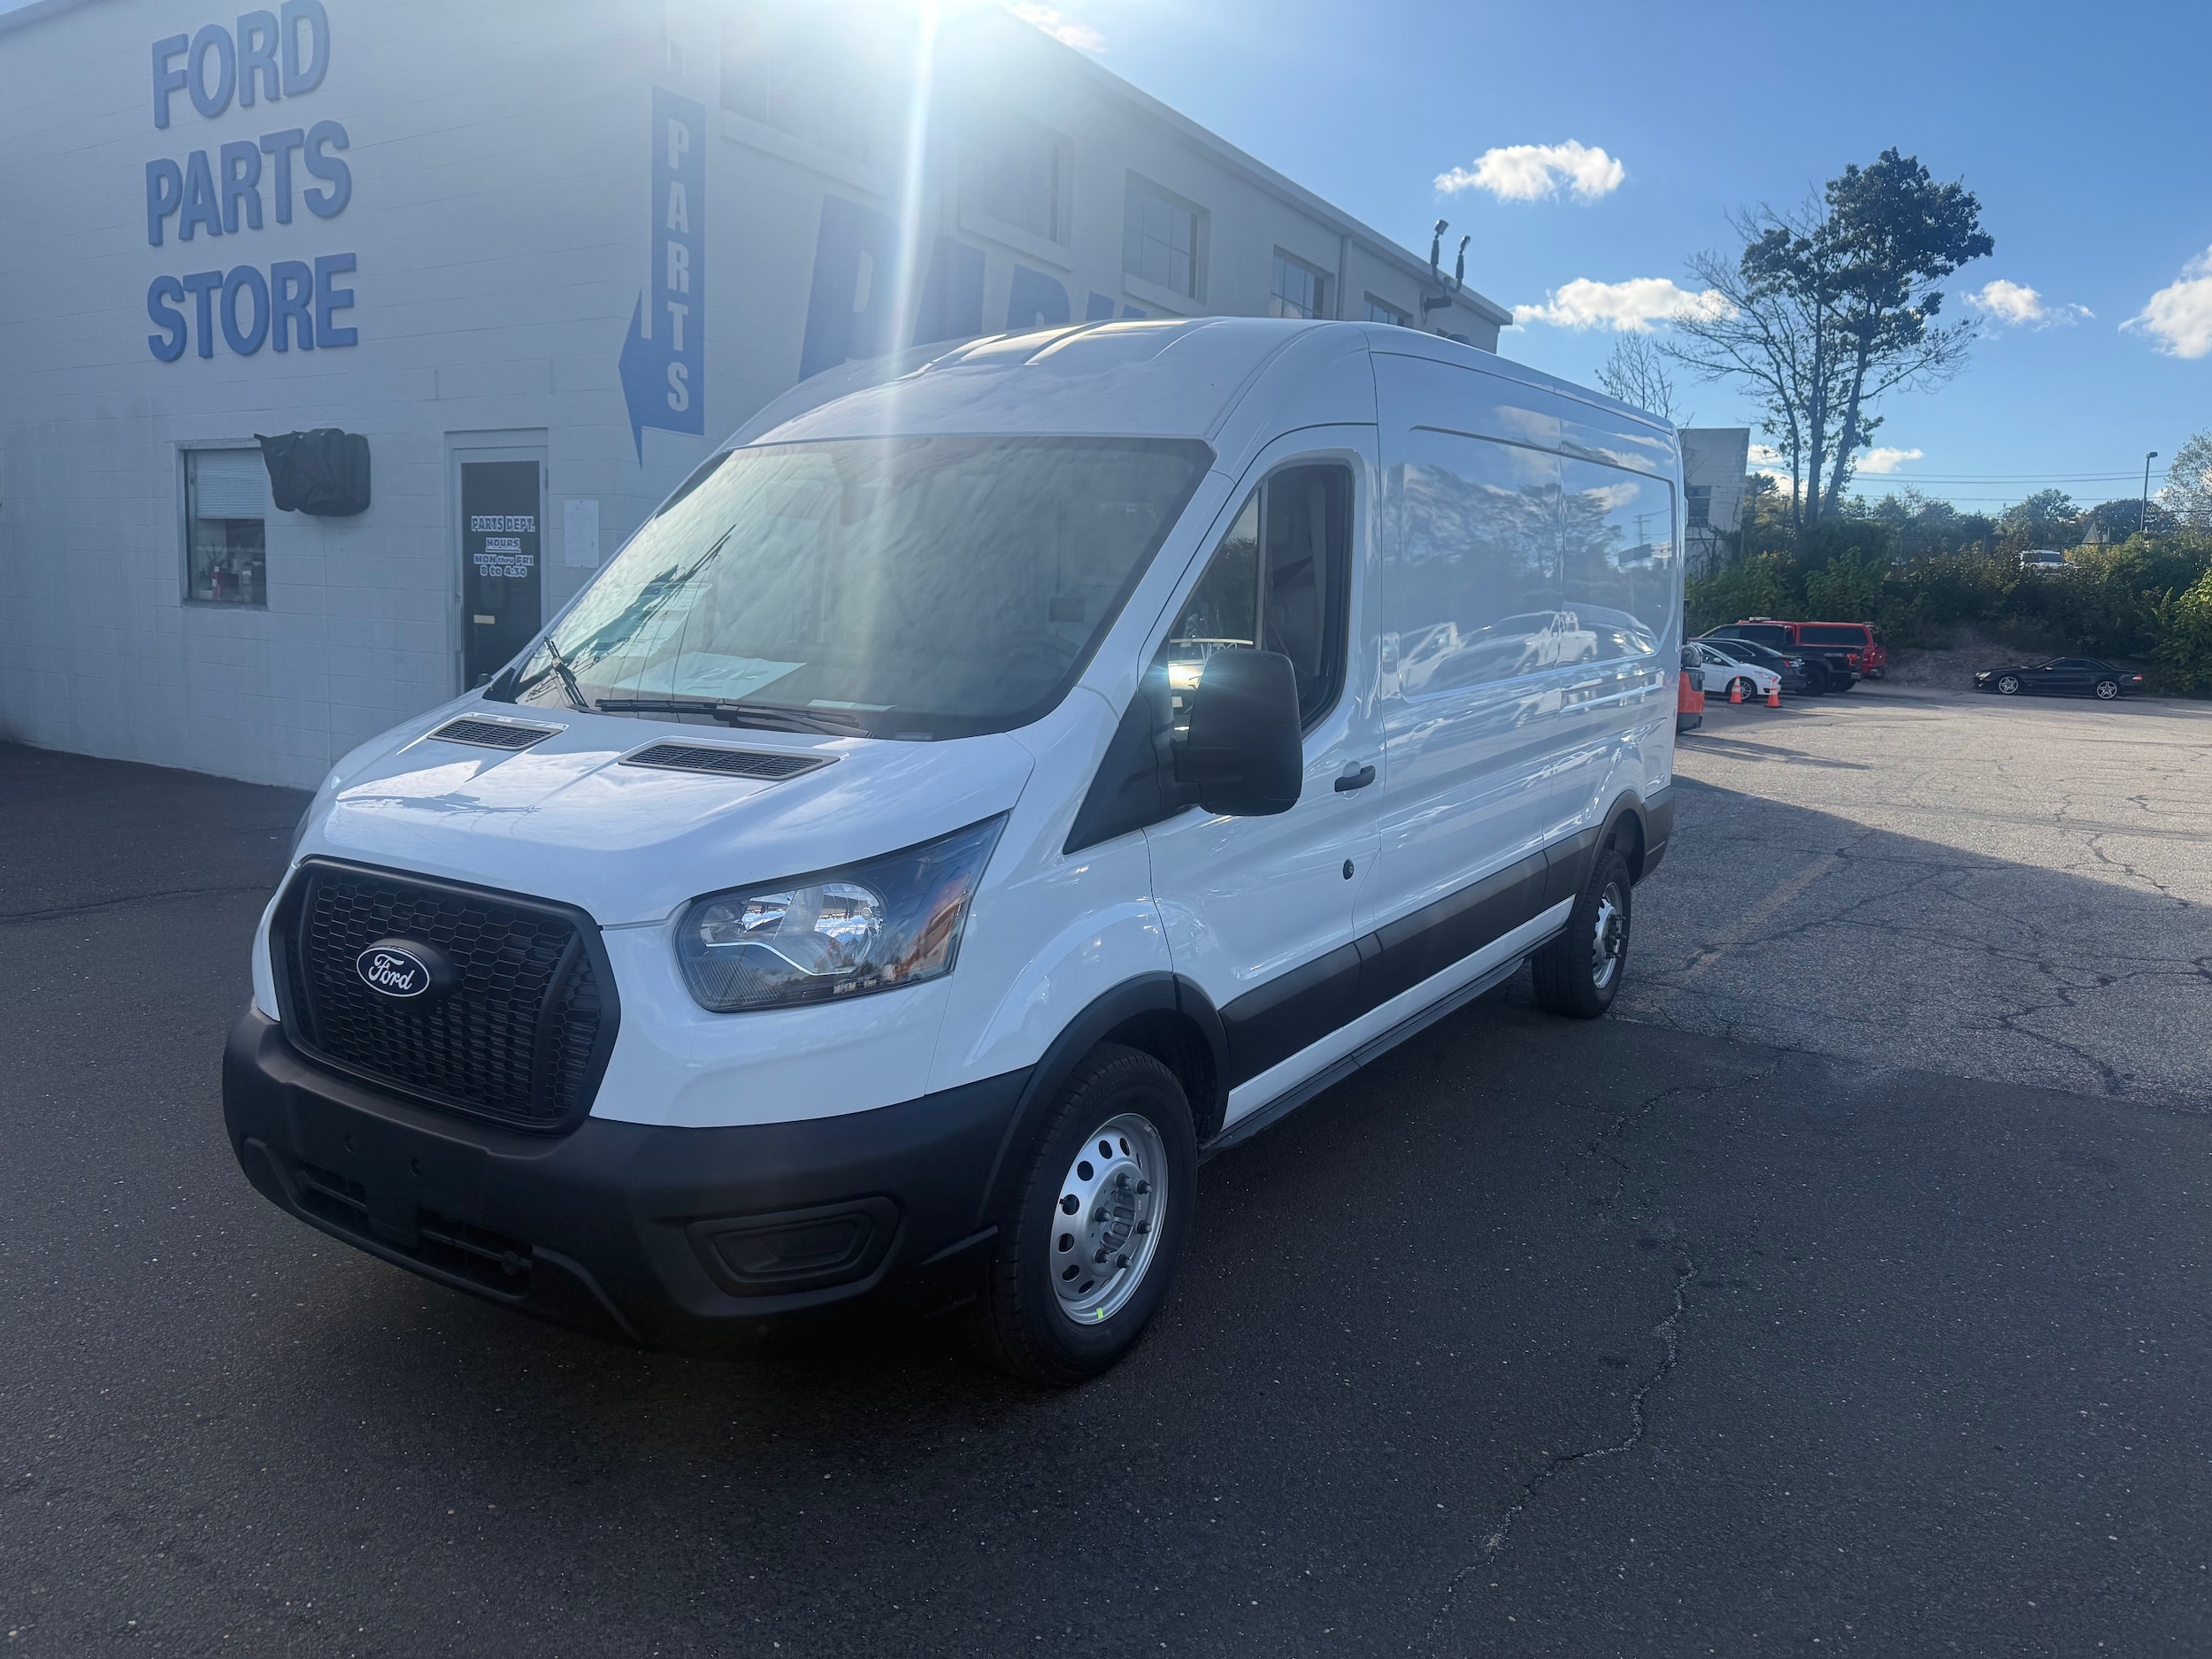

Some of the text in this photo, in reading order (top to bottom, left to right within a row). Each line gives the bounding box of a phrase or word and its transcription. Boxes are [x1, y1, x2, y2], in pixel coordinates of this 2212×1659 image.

[152, 0, 330, 128] FORD
[146, 119, 352, 247] PARTS
[666, 118, 690, 412] PARTS
[147, 252, 358, 363] STORE
[471, 515, 536, 532] PARTS DEPT.
[473, 553, 534, 566] MON thru FRI
[485, 537, 520, 549] HOURS
[480, 565, 528, 578] 8 to 4:30
[368, 954, 415, 990] Ford
